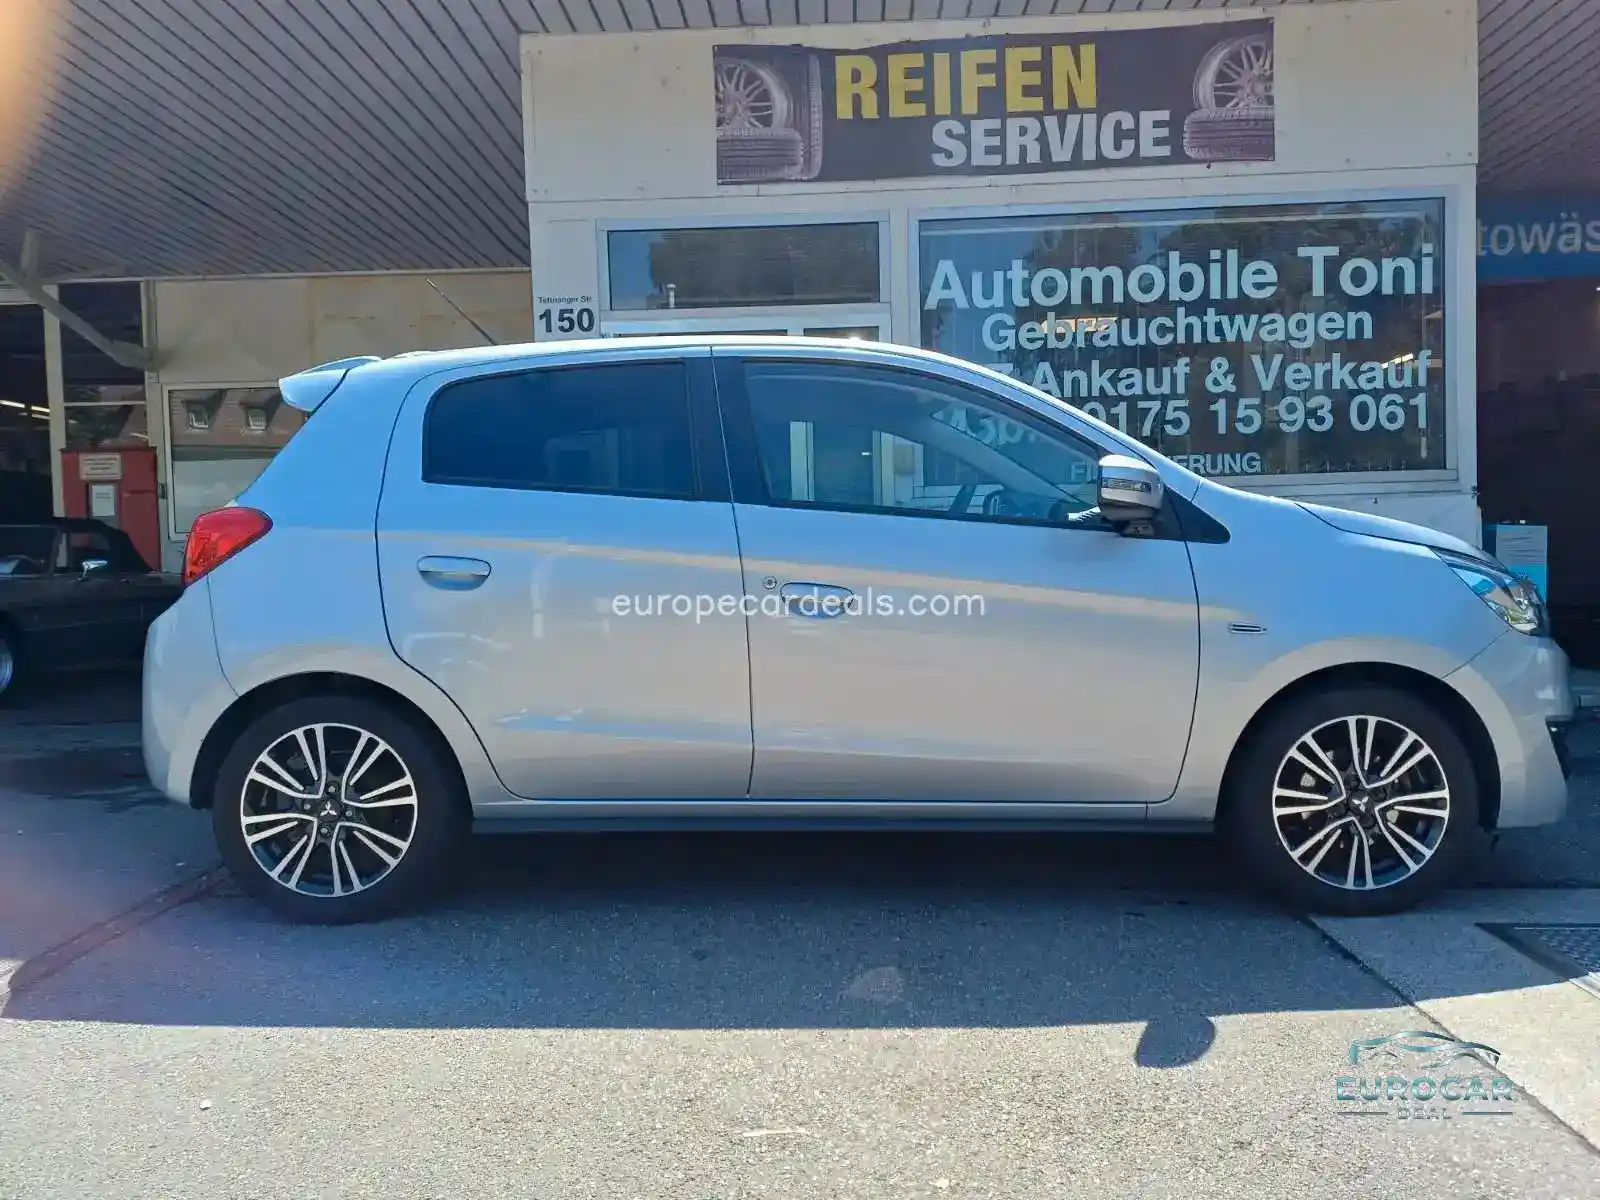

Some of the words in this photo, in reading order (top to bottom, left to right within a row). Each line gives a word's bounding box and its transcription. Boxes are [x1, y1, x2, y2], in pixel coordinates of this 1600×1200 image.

[835, 44, 1097, 120] REIFEN
[931, 109, 1171, 168] SERVICE
[924, 249, 1278, 311] Automobile
[1297, 244, 1434, 297] Toni
[538, 307, 595, 333] 150
[981, 306, 1373, 352] Gebrauchtwagen
[1031, 357, 1191, 398] Ankauf
[1204, 356, 1237, 394] &
[1250, 349, 1432, 392] Verkauf
[1209, 397, 1262, 436] 15
[1278, 394, 1334, 434] 93
[1349, 392, 1428, 432] 061
